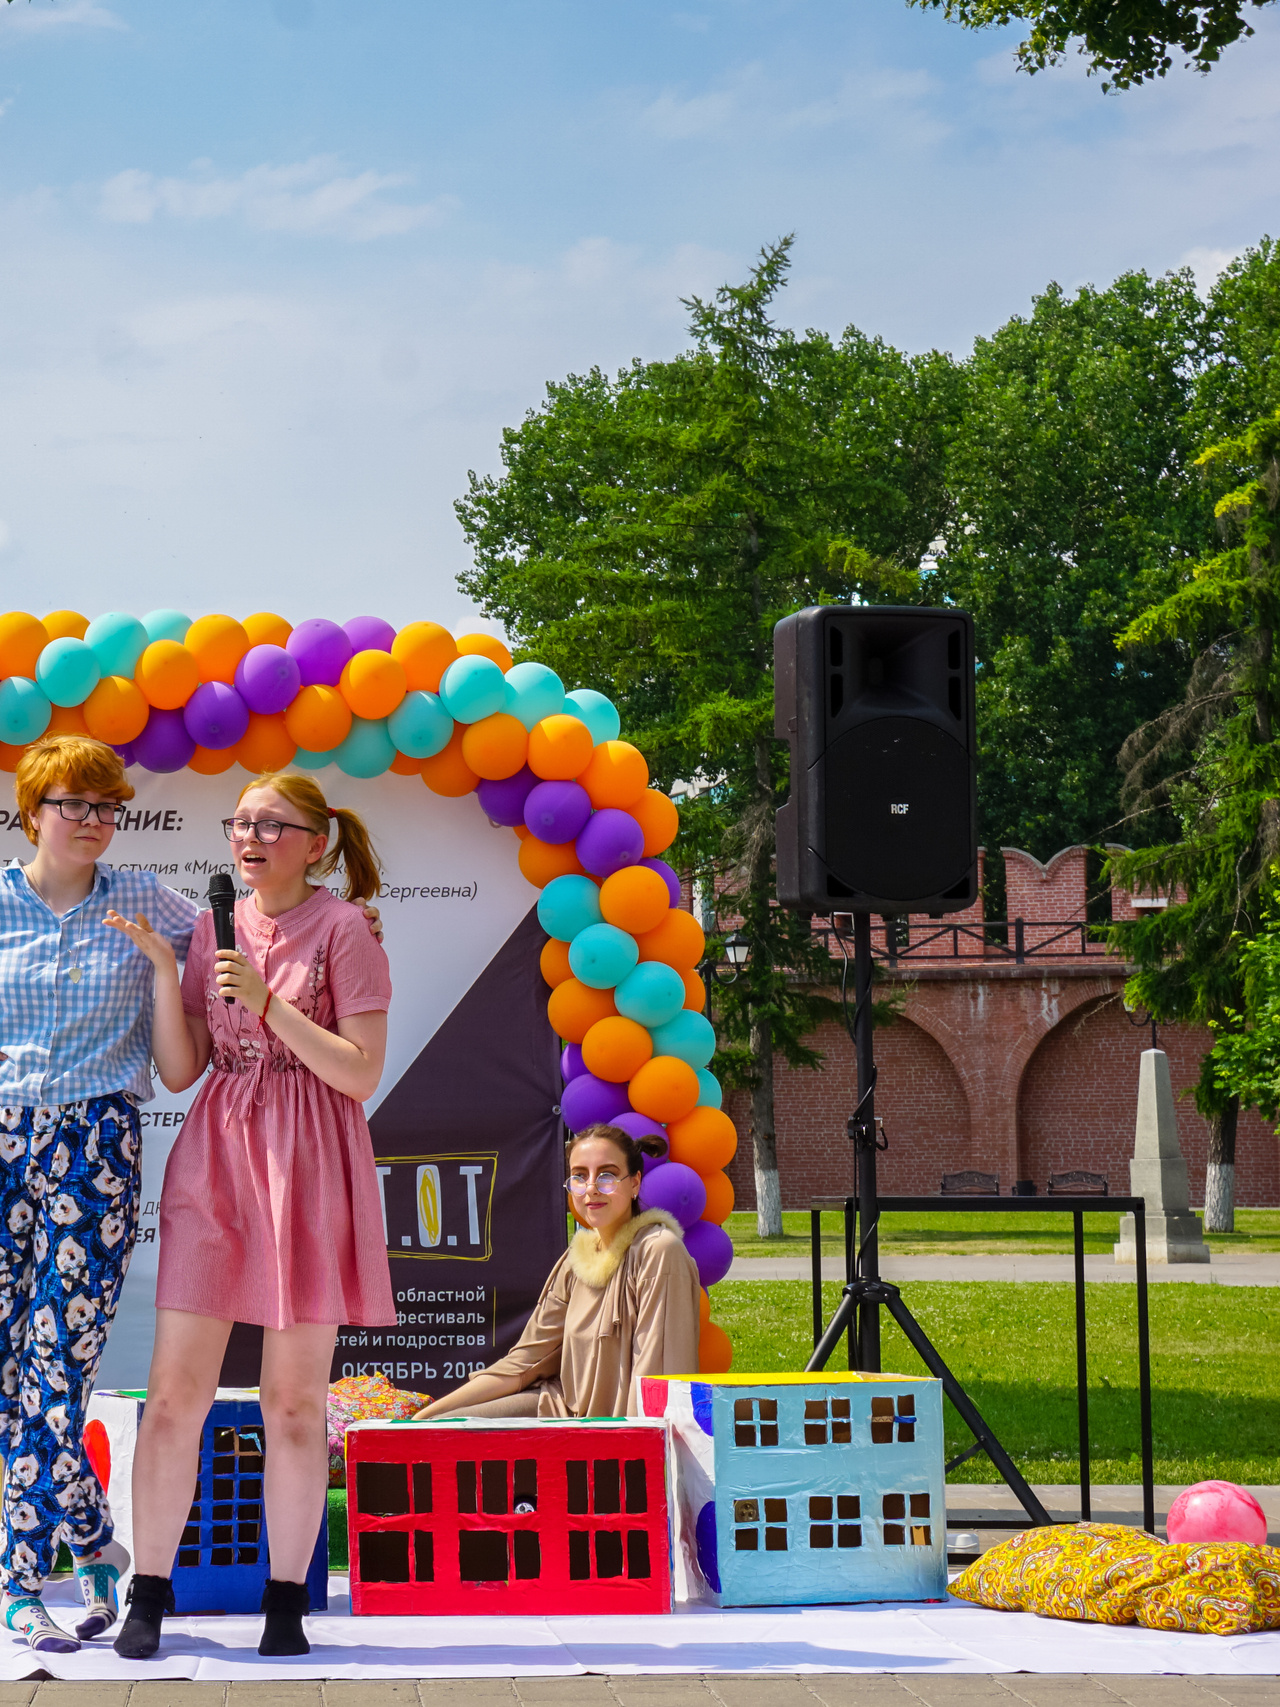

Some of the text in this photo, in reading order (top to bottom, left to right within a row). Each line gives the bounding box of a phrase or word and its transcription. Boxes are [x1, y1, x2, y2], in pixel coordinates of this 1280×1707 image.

[890, 803, 909, 814] RCF
[378, 881, 478, 902] Сергеевна)
[397, 1286, 486, 1302] областной
[396, 1310, 486, 1326] фестиваль
[334, 1330, 368, 1346] етей
[372, 1335, 382, 1347] и
[341, 1361, 437, 1379] ОКТЯБРЬ
